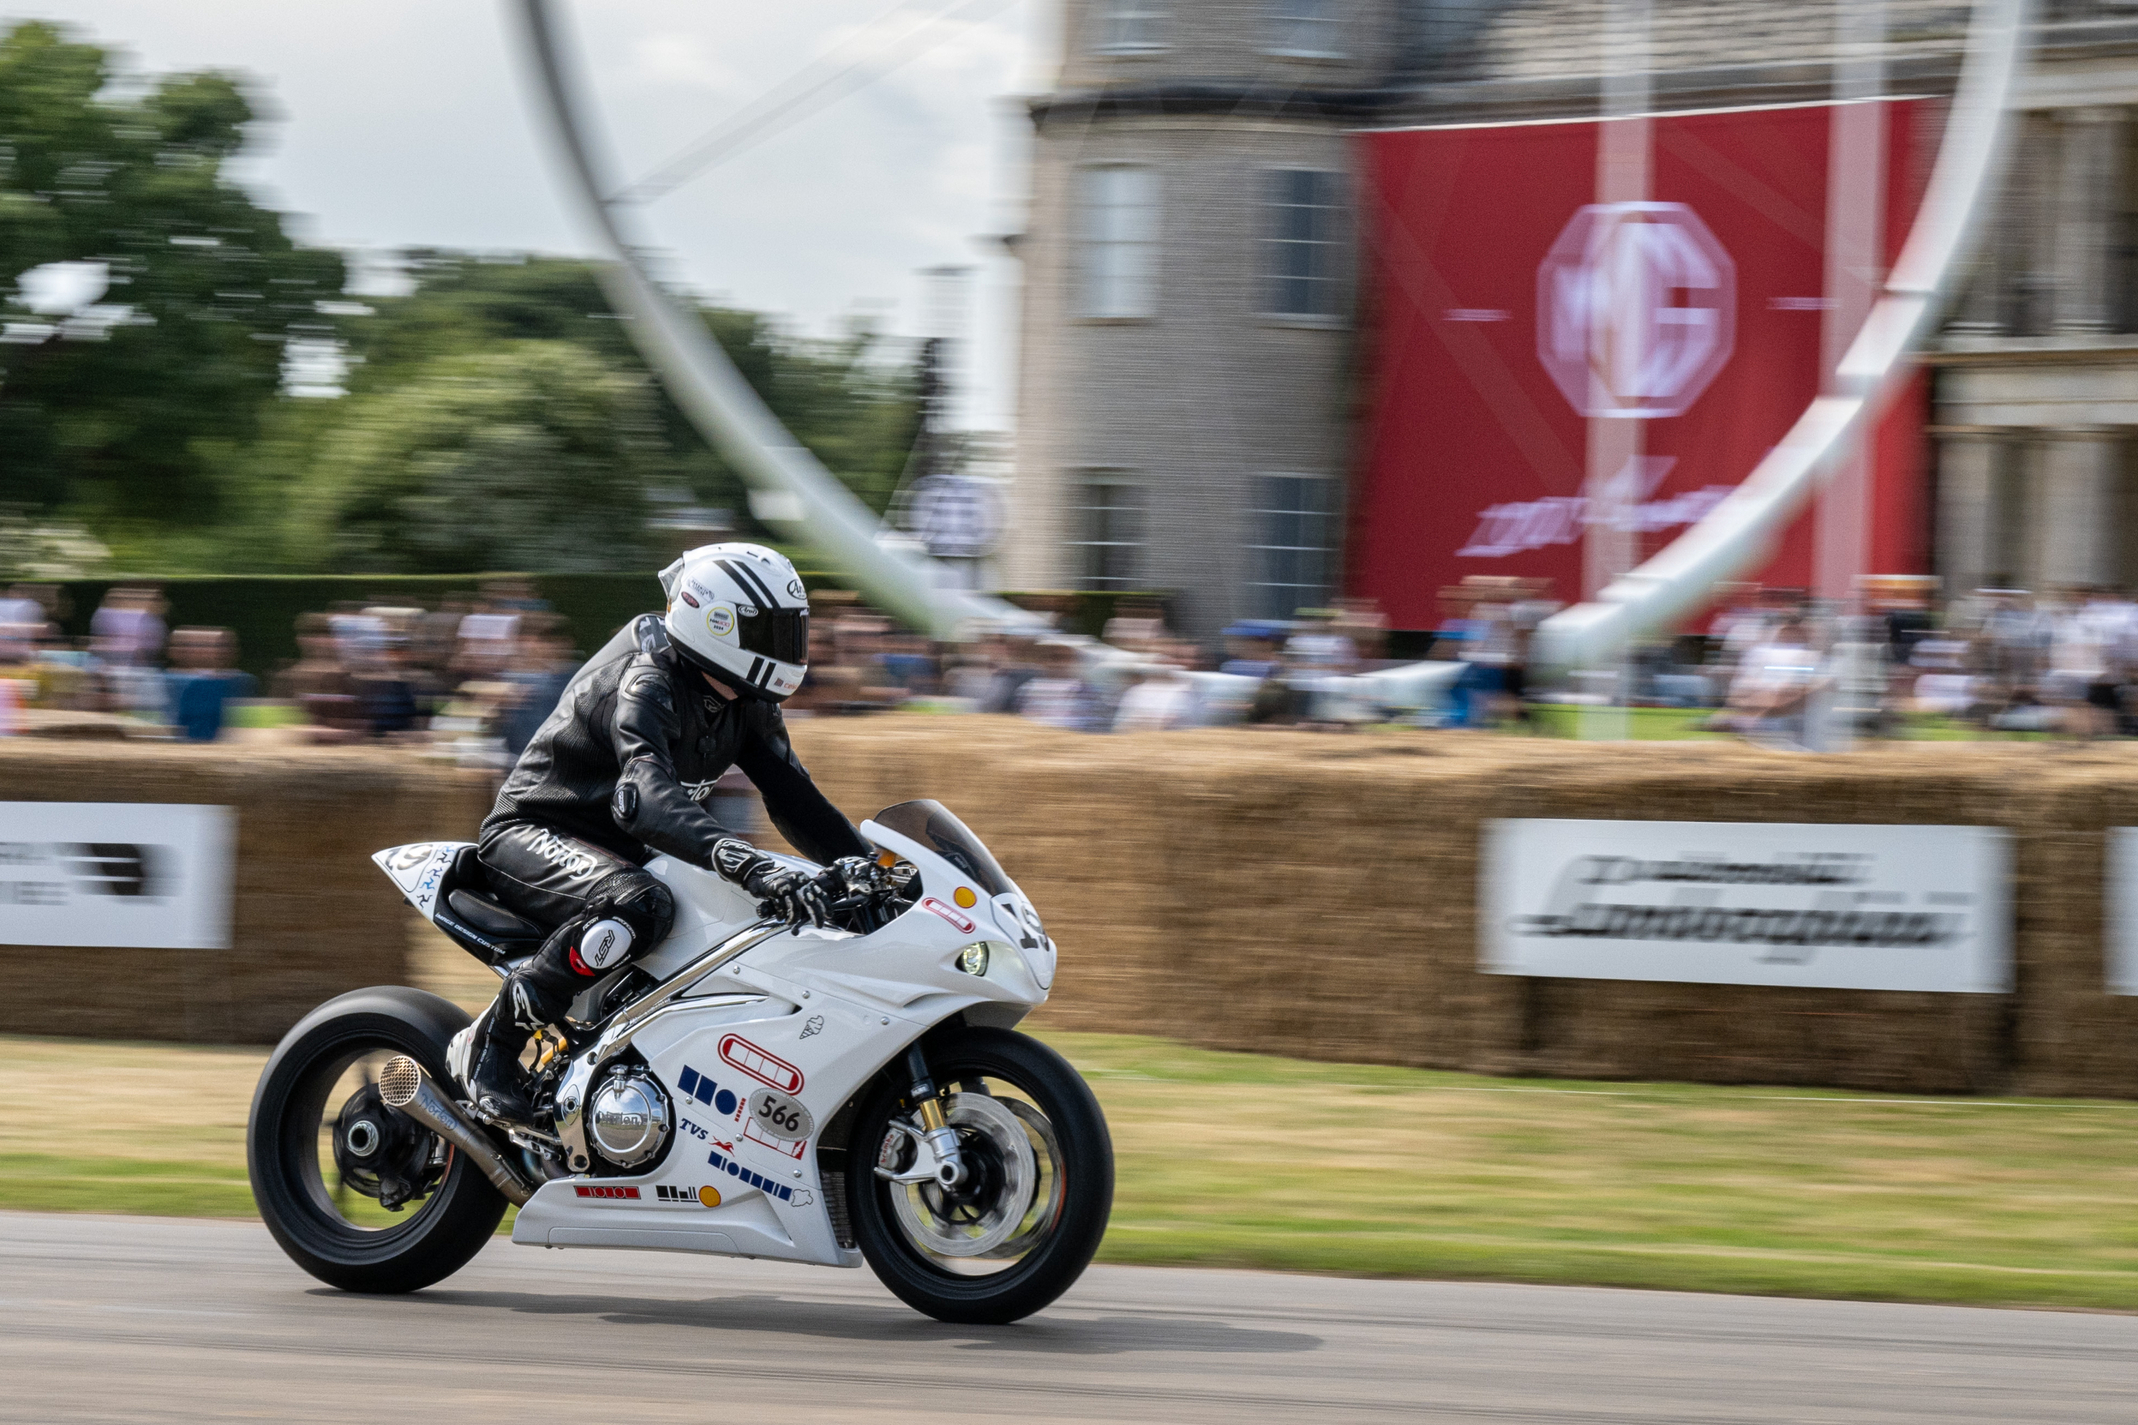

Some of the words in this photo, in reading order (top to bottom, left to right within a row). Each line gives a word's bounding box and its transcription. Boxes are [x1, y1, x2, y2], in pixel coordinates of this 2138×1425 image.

[526, 828, 598, 881] Norton
[454, 924, 478, 940] DESIGN
[477, 937, 506, 955] CUSTOM
[594, 930, 615, 966] RST
[419, 1093, 458, 1131] Norton
[679, 1118, 709, 1140] TVS
[758, 1095, 800, 1132] 566
